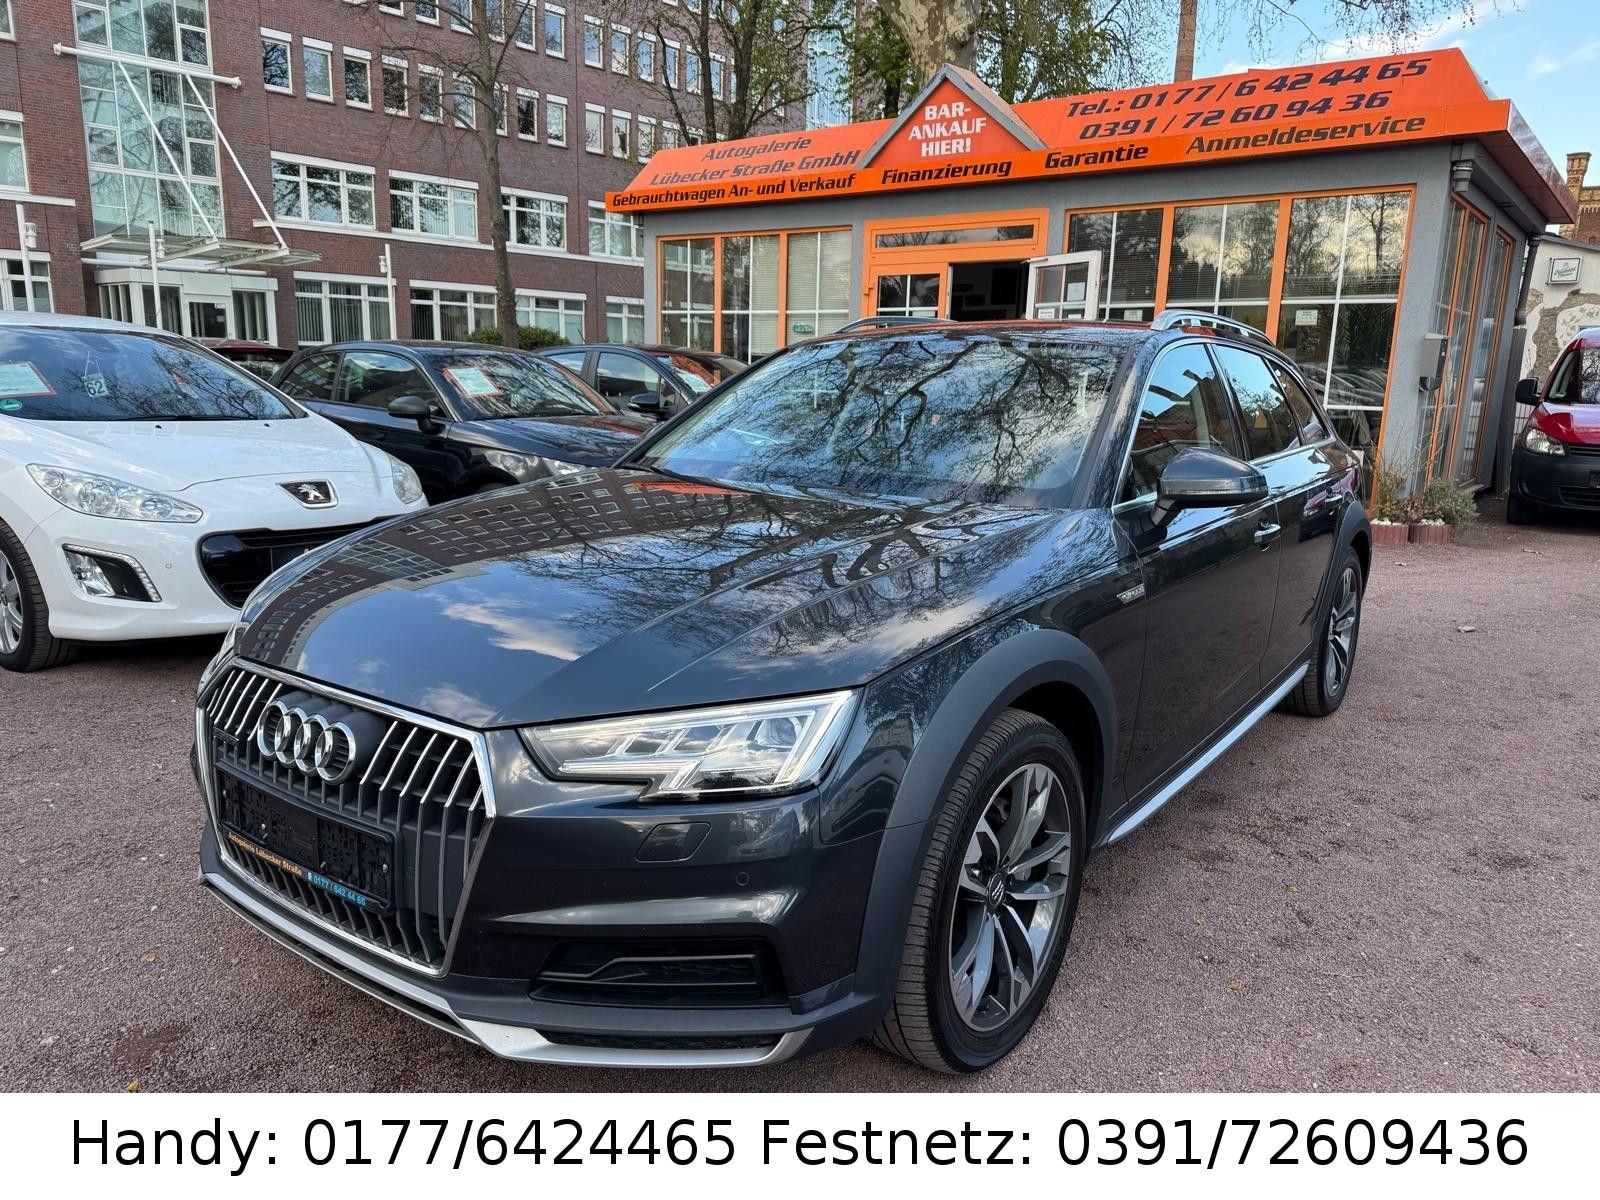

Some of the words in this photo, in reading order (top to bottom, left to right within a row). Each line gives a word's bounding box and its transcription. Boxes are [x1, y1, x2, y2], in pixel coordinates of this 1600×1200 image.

[1067, 98, 1124, 118] Tel.:
[1129, 84, 1217, 110] 0177
[1263, 72, 1314, 93] 42
[1318, 65, 1371, 86] 44
[1376, 58, 1432, 80] 65
[924, 101, 972, 121] BAR-
[1079, 117, 1158, 140] 0391
[1182, 109, 1226, 129] 72
[1229, 103, 1279, 123] 60
[1282, 97, 1334, 118] 94
[1338, 90, 1393, 112] 36
[908, 117, 987, 141] ANKAUF
[1185, 116, 1426, 155] Anmeldeservice
[701, 137, 812, 162] Autogalerie
[920, 137, 972, 157] HIER!
[1044, 143, 1149, 169] Garantie
[649, 168, 729, 186] Lübecker
[730, 159, 795, 178] Straße
[797, 149, 861, 170] GmbH
[881, 160, 1012, 184] Finanzierung
[613, 187, 726, 207] Gebrauchtwagen
[728, 184, 753, 198] An-
[756, 180, 786, 195] und
[789, 173, 857, 193] Verkauf
[86, 380, 105, 396] 62
